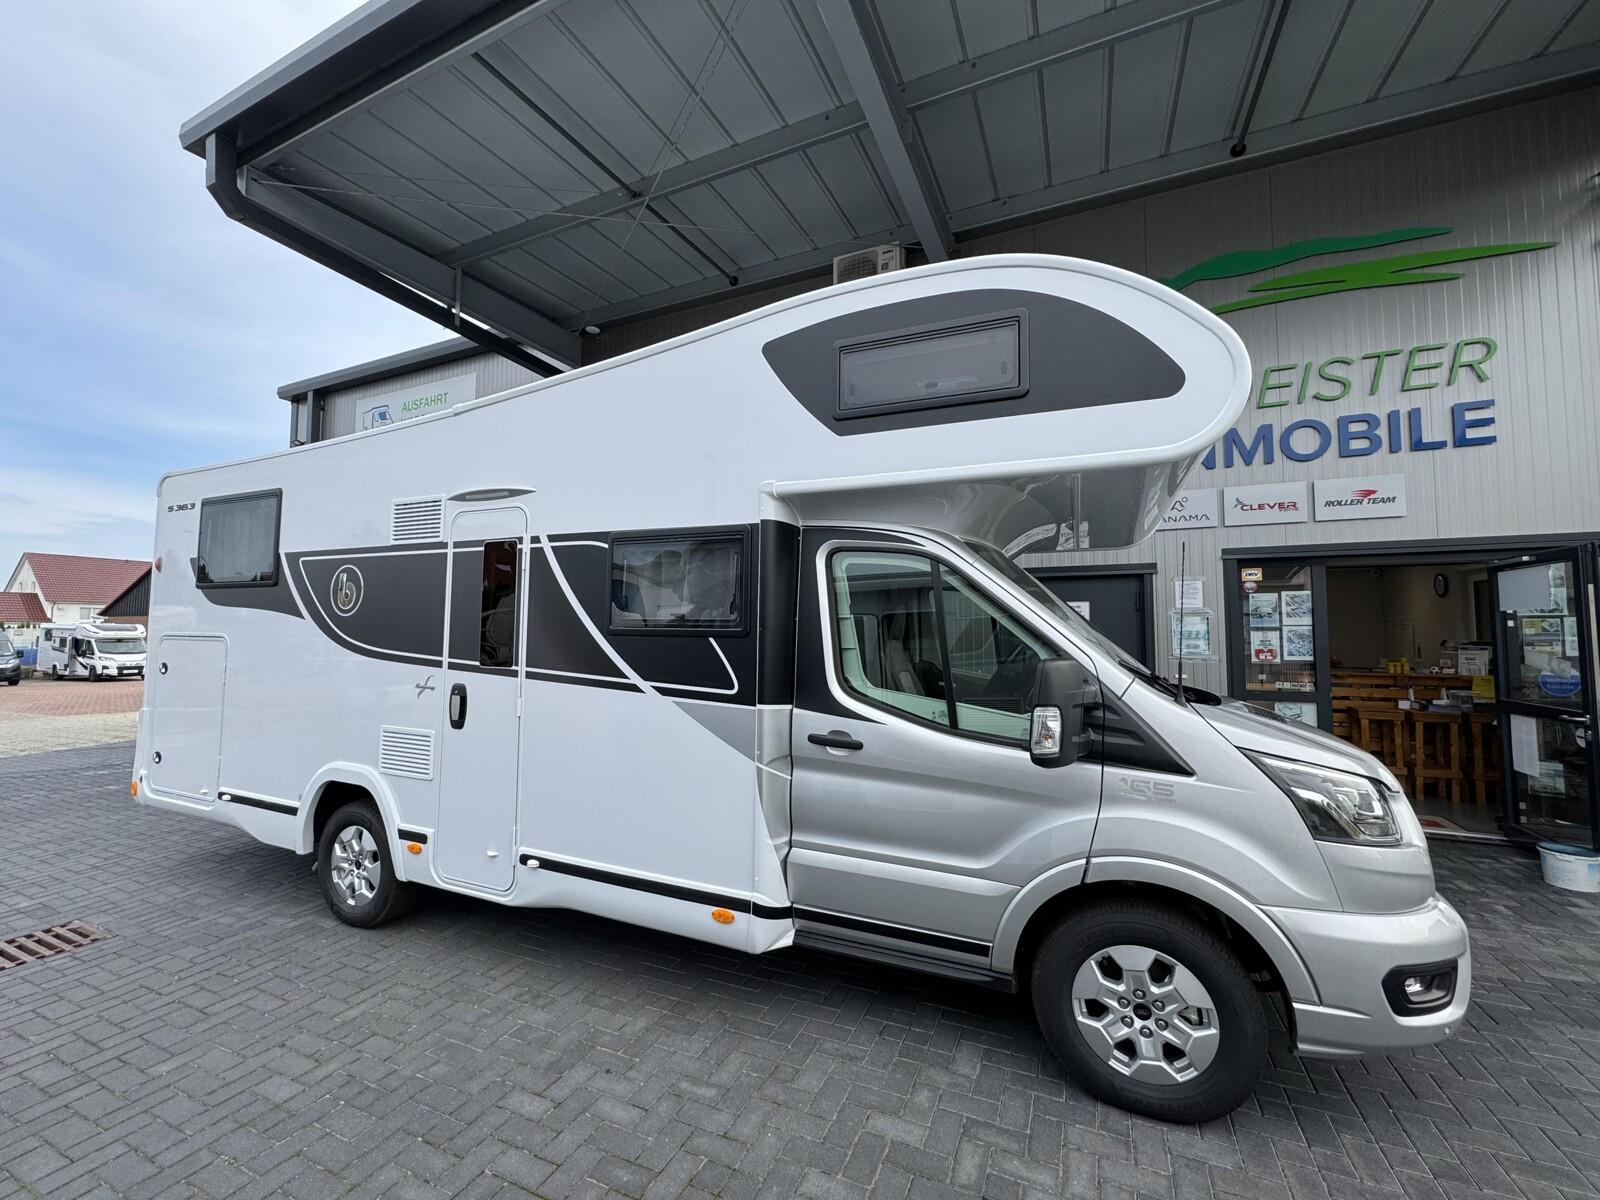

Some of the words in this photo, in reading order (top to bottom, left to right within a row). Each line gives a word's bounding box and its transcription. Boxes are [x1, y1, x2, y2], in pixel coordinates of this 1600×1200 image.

[1257, 337, 1498, 409] EISTER
[401, 392, 449, 413] AUSFAHRT
[175, 502, 196, 512] 363
[1240, 501, 1298, 512] CLEVER
[1324, 499, 1364, 508] ROLLER
[1367, 496, 1397, 505] TEAM
